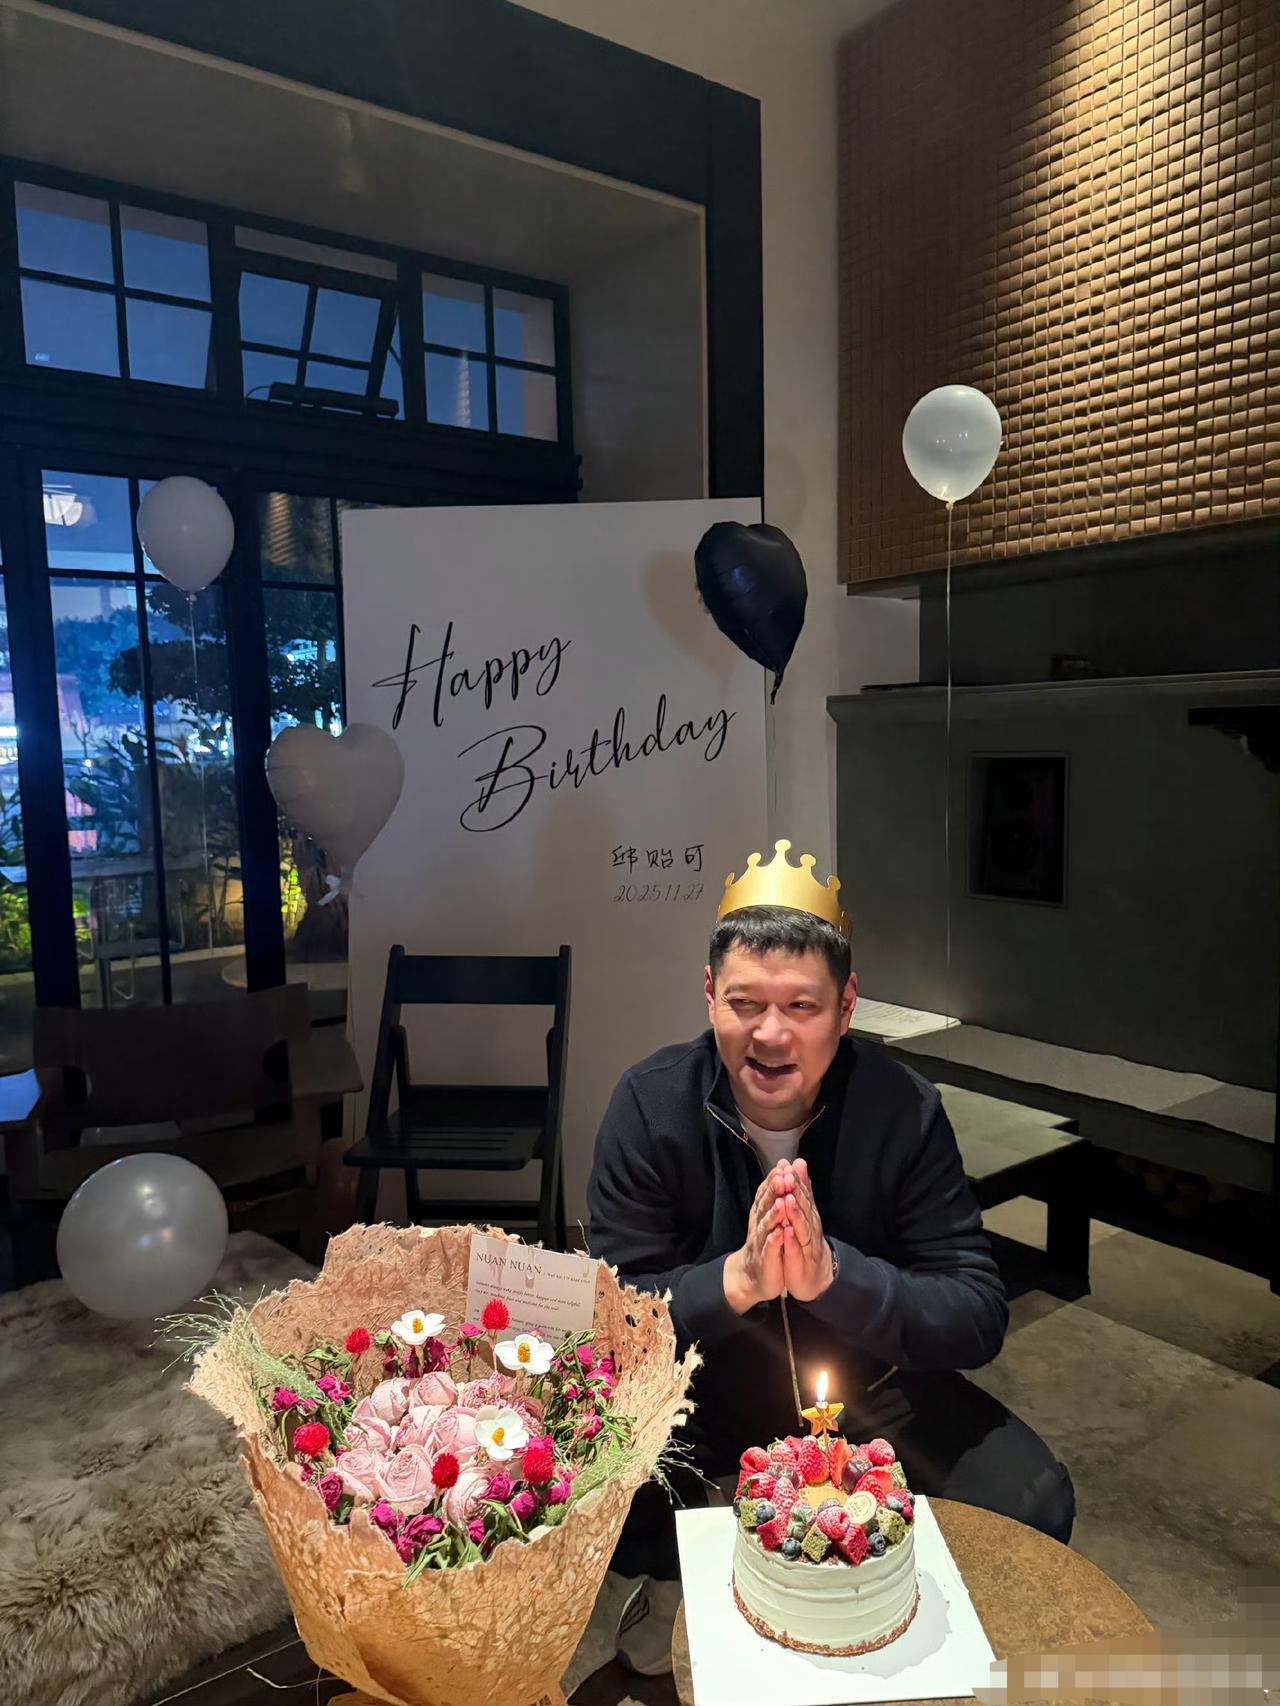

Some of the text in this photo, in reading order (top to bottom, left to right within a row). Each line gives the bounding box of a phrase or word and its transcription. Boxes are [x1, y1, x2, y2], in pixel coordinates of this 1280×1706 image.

[372, 621, 572, 730] Happy
[458, 694, 737, 832] Birthday
[612, 844, 704, 875] 邱贻可
[475, 1252, 542, 1275] NUAN NUAN
